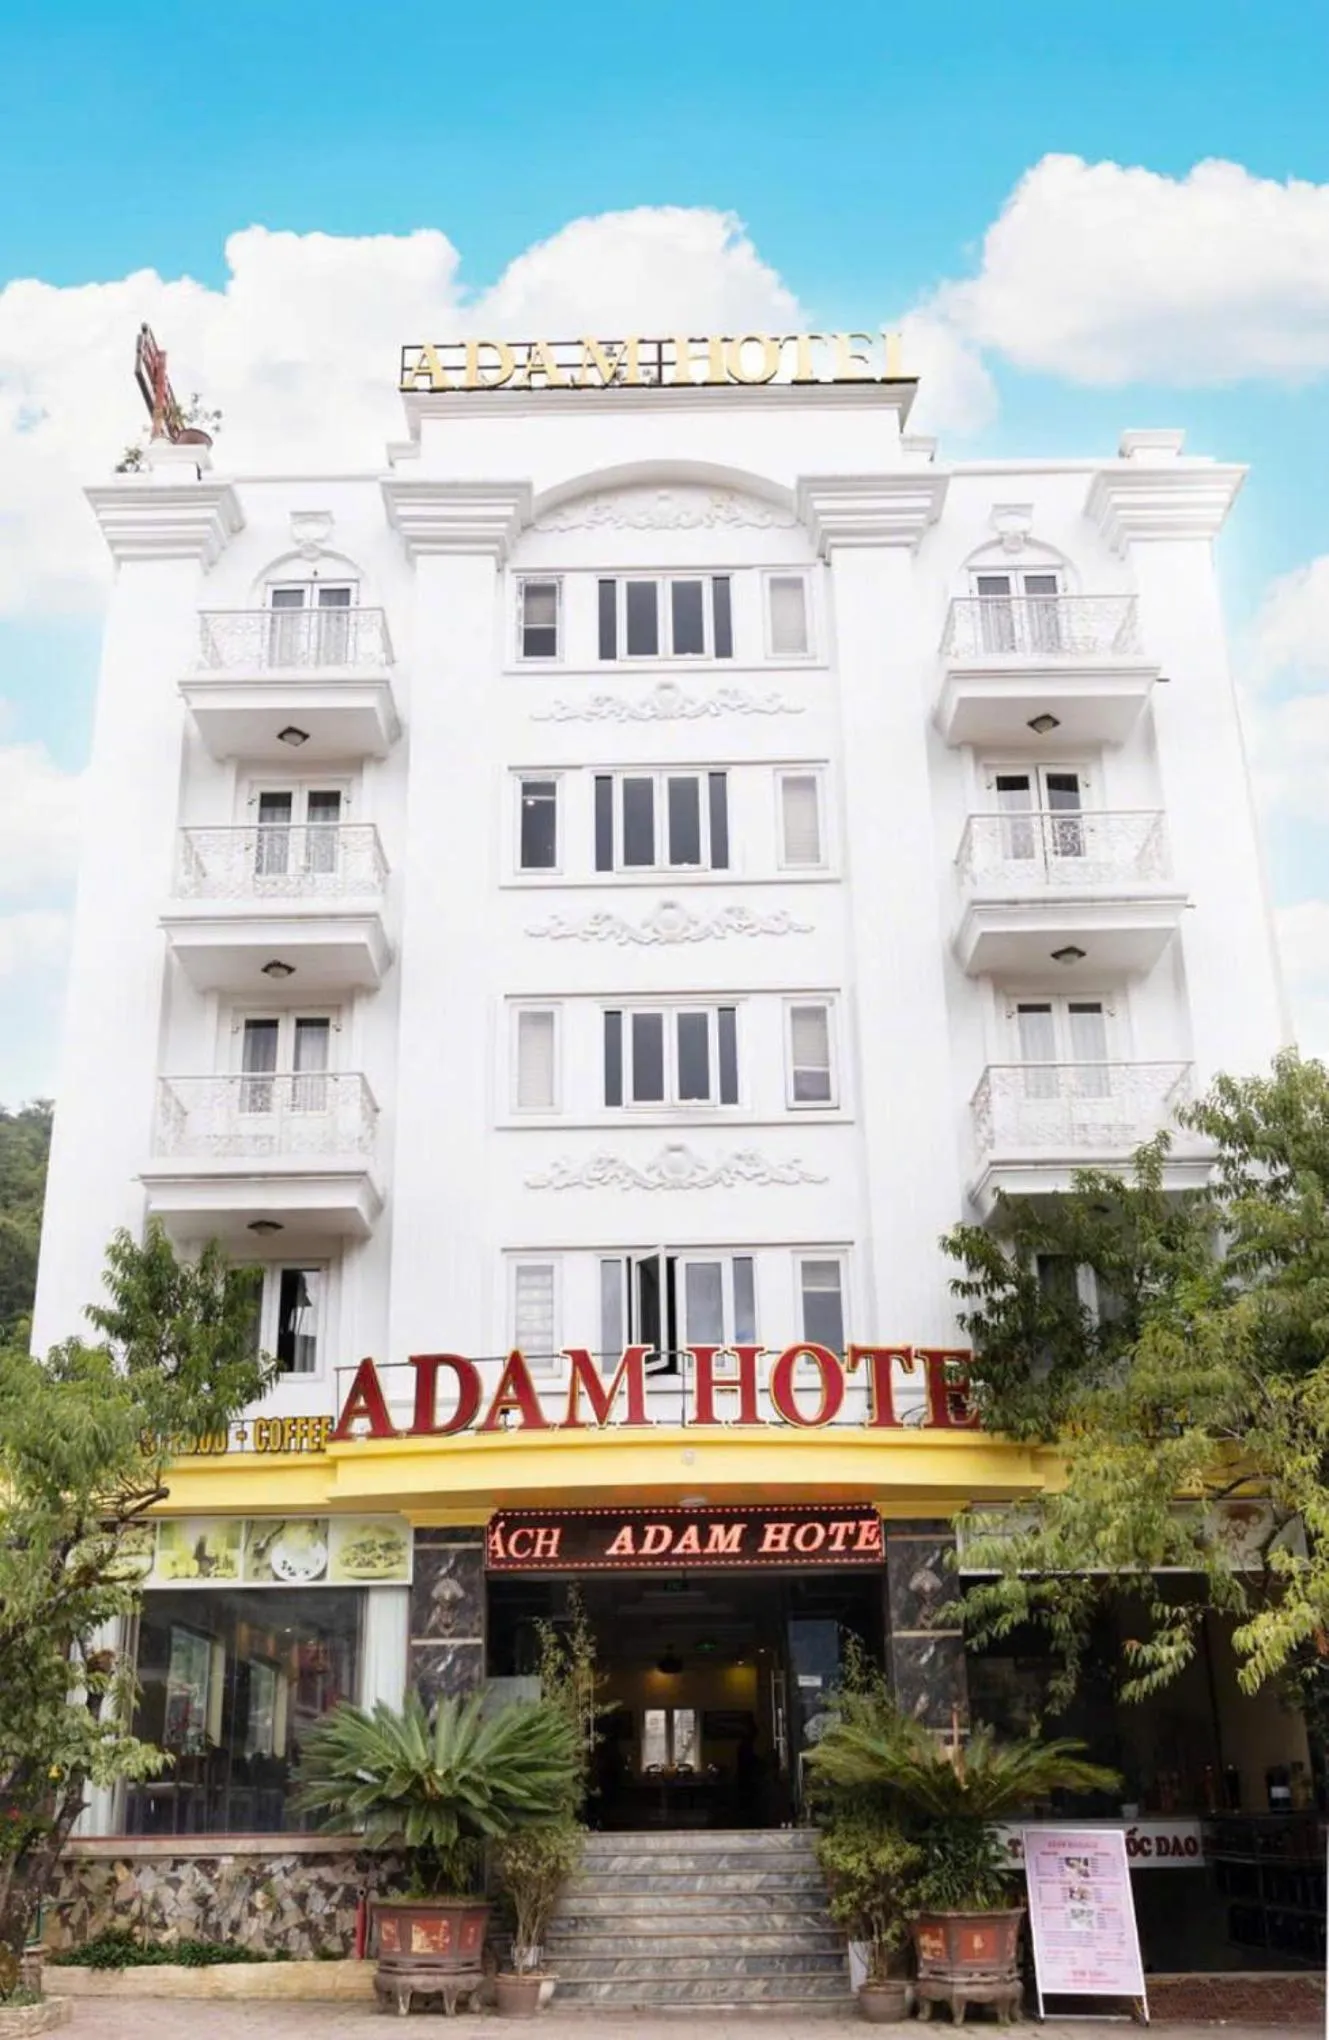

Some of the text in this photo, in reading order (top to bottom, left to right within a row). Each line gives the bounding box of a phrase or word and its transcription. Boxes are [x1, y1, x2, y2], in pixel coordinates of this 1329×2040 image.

[400, 332, 918, 391] ADAM HOTEL
[326, 1341, 982, 1440] ADAM HOTE
[253, 1416, 334, 1454] COFFEE
[605, 1523, 747, 1556] ADAM
[757, 1519, 881, 1552] HOTE
[1155, 1835, 1198, 1858] DAO
